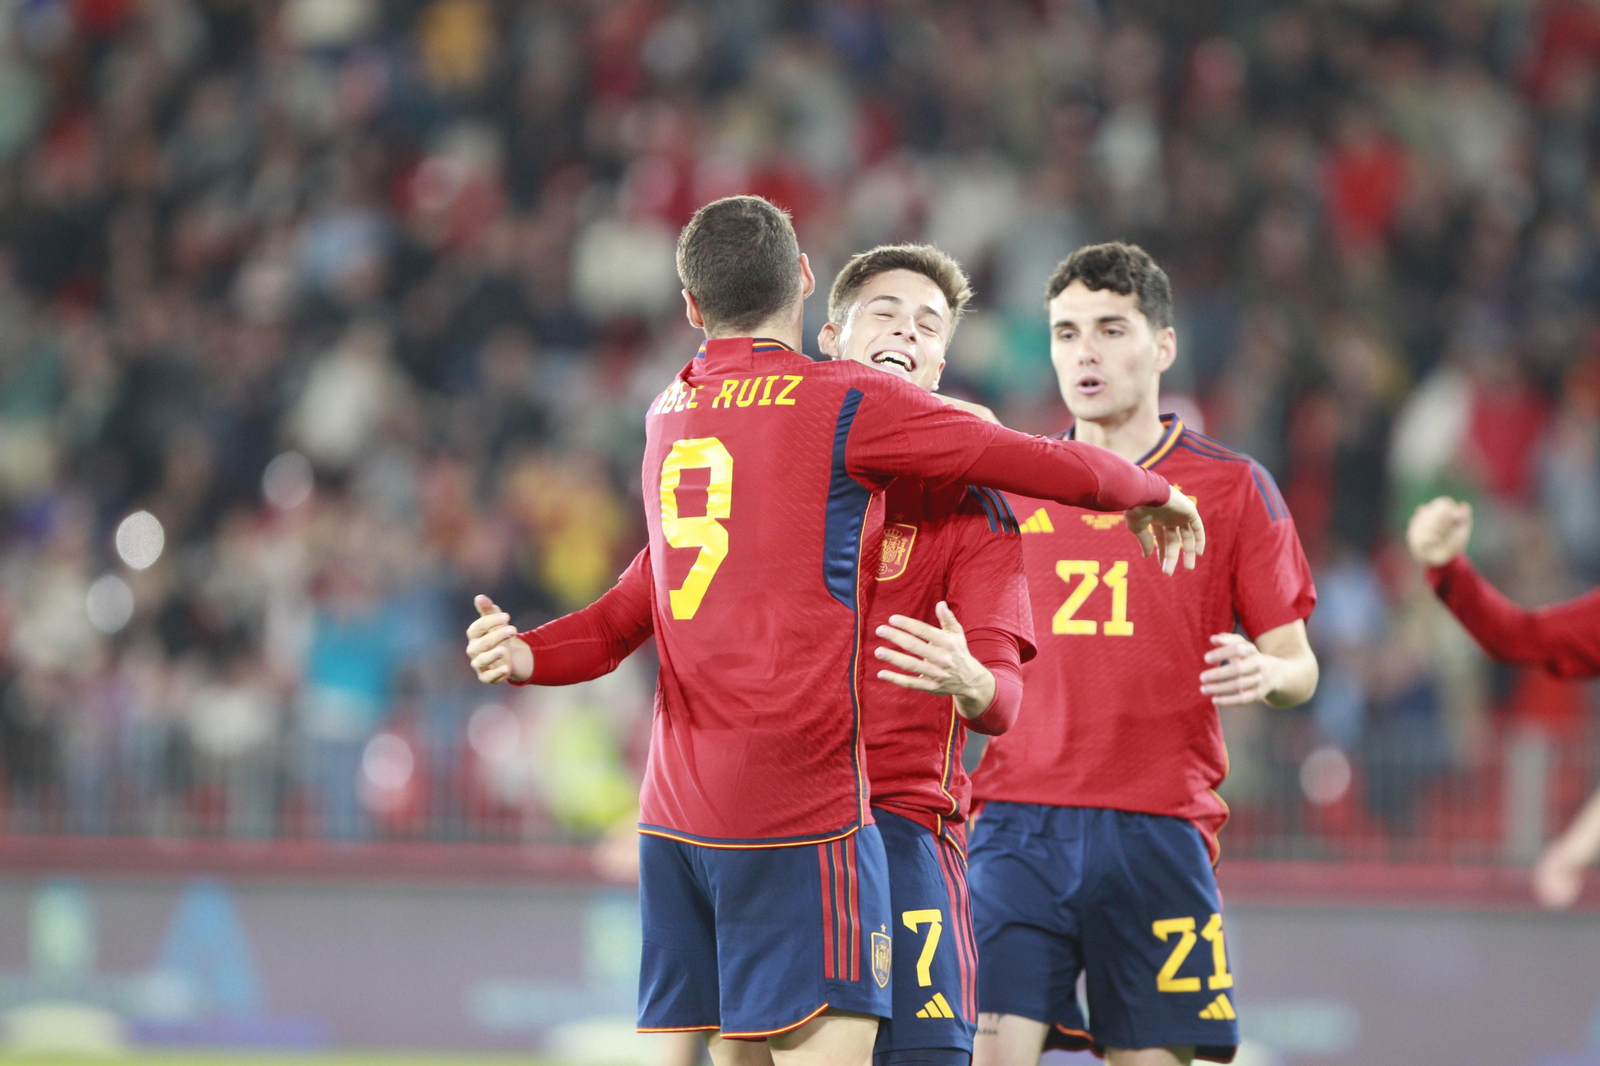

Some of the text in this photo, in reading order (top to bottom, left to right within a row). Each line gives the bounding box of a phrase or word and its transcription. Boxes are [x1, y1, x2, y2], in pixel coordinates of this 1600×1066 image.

[712, 375, 804, 409] RUIZ
[661, 438, 733, 620] 9
[1052, 560, 1134, 636] 21
[902, 908, 943, 987] 7
[1151, 913, 1233, 992] 21
